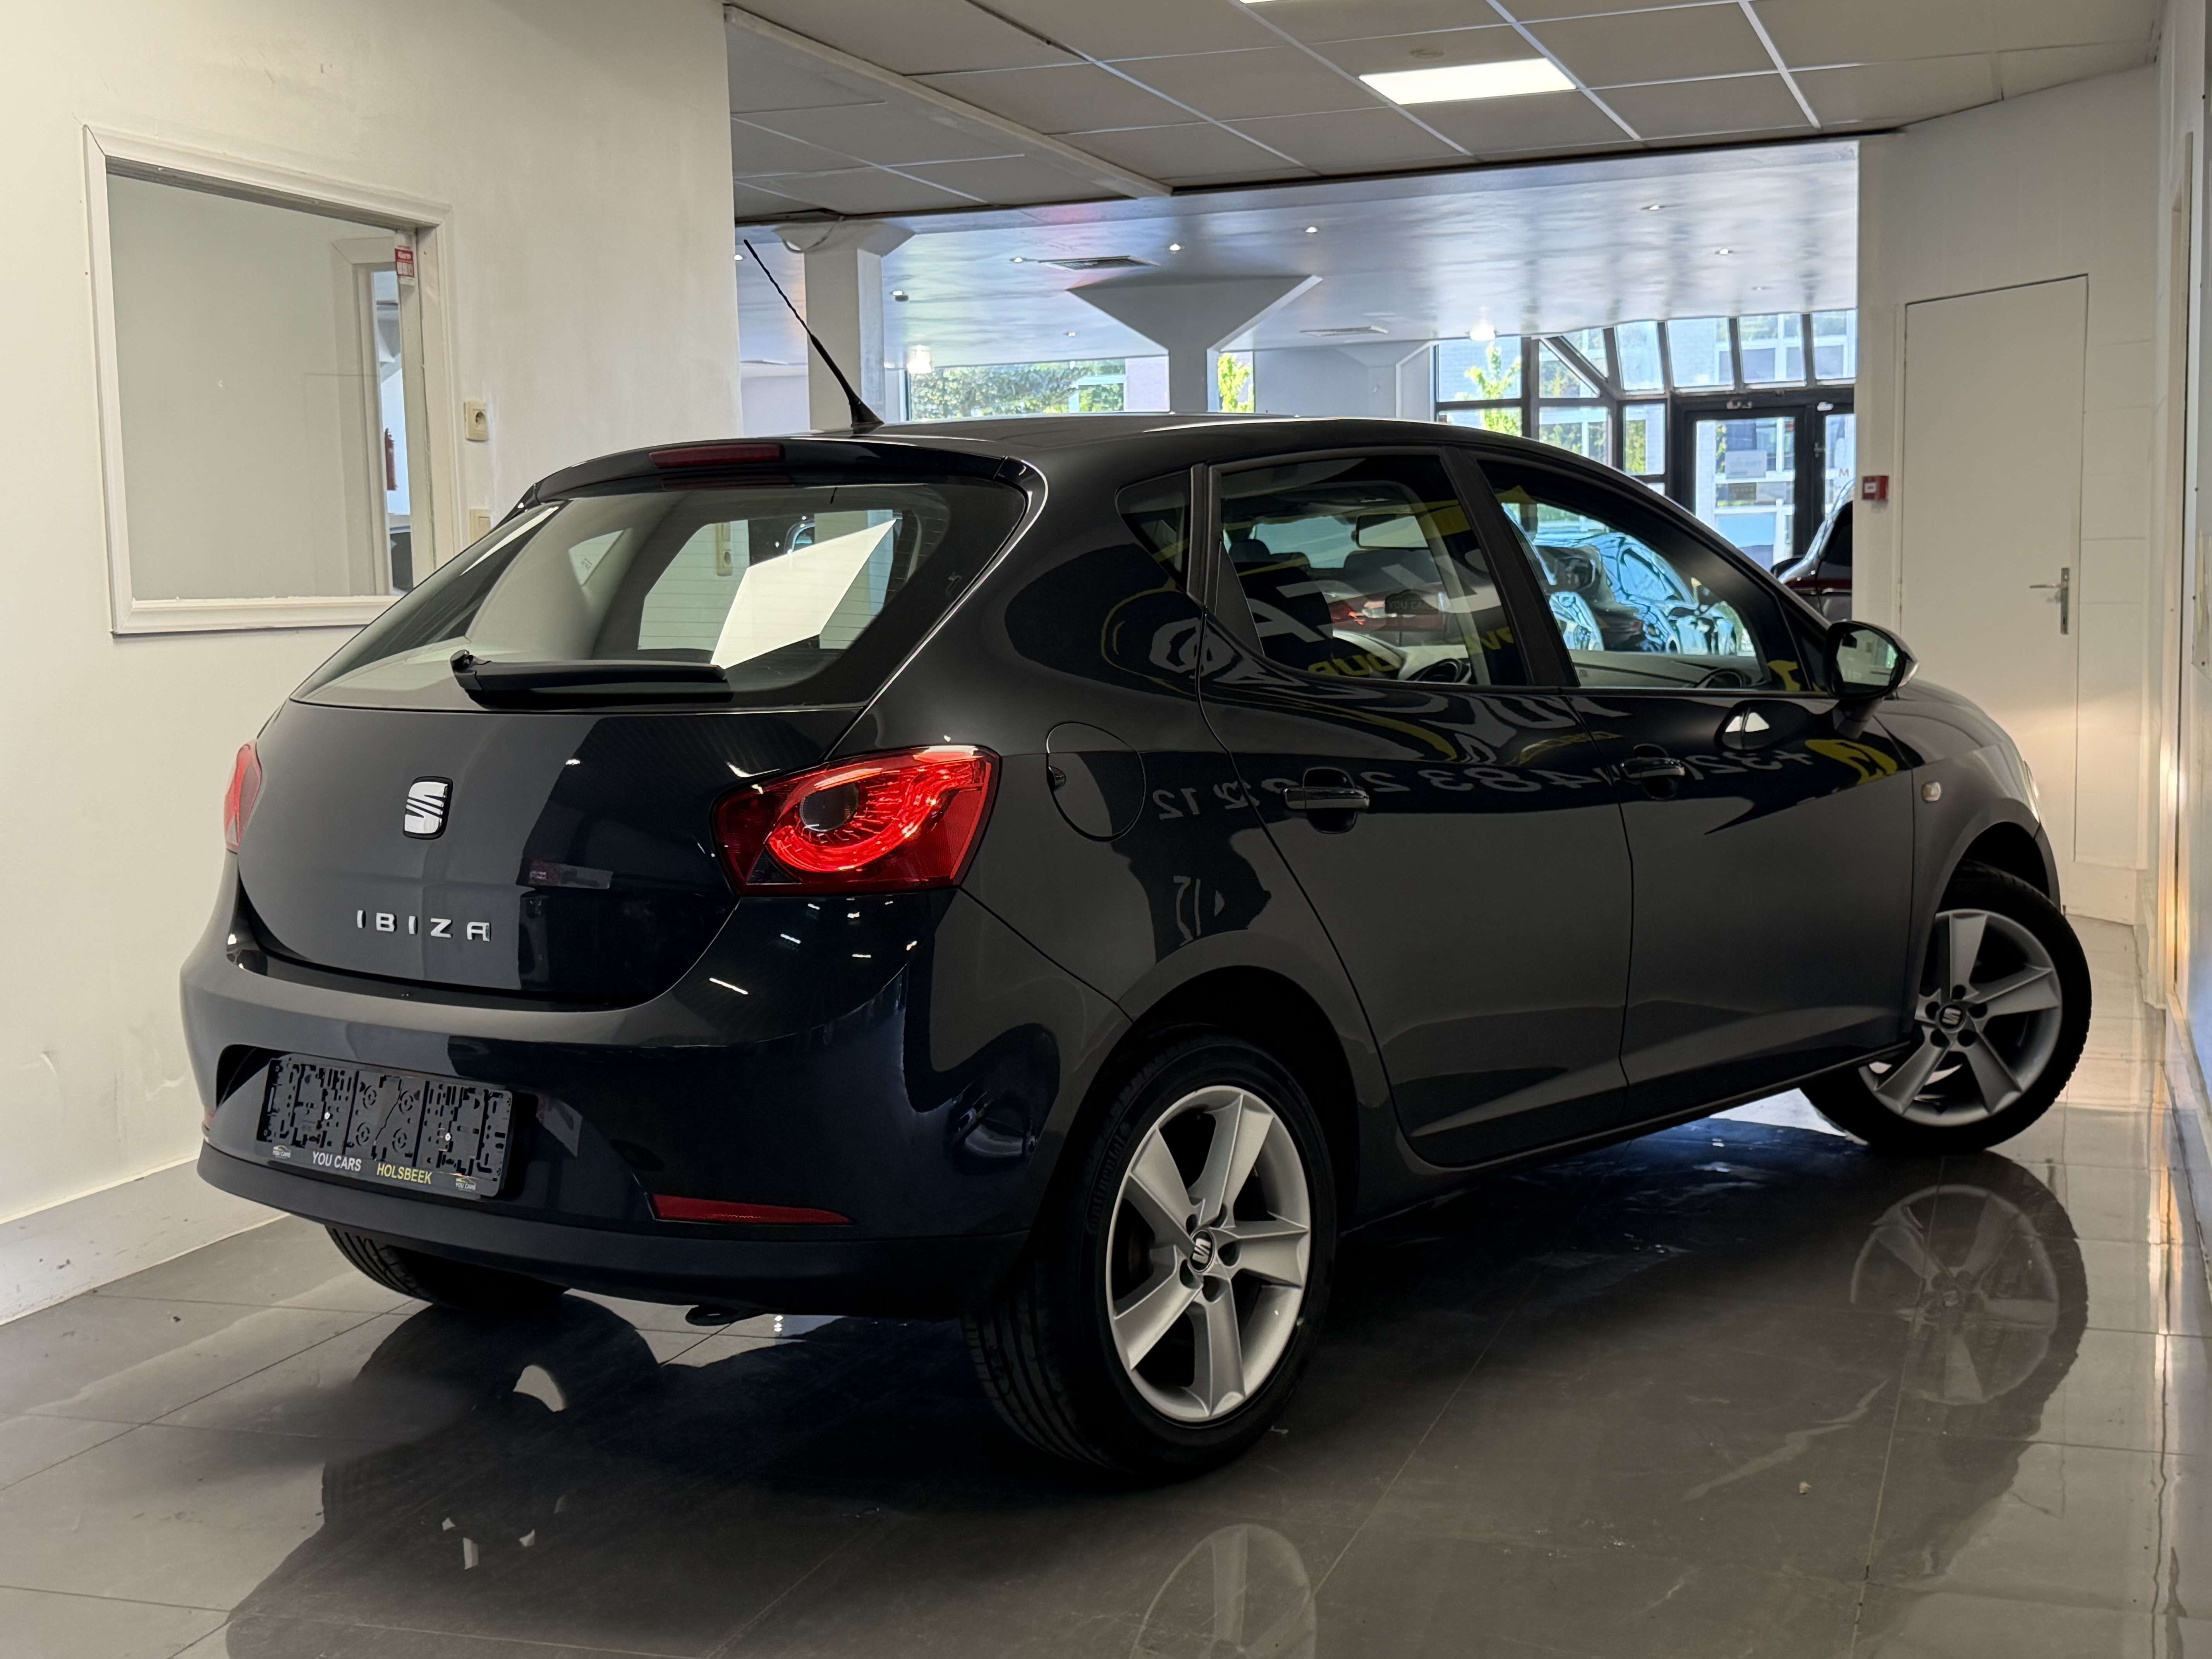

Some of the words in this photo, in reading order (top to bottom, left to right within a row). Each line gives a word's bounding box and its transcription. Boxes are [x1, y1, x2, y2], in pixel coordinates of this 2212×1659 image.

[356, 909, 491, 942] IBIZA
[312, 1151, 333, 1167] YOU
[334, 1156, 362, 1172] CARS
[376, 1163, 433, 1184] HOLSBEEK
